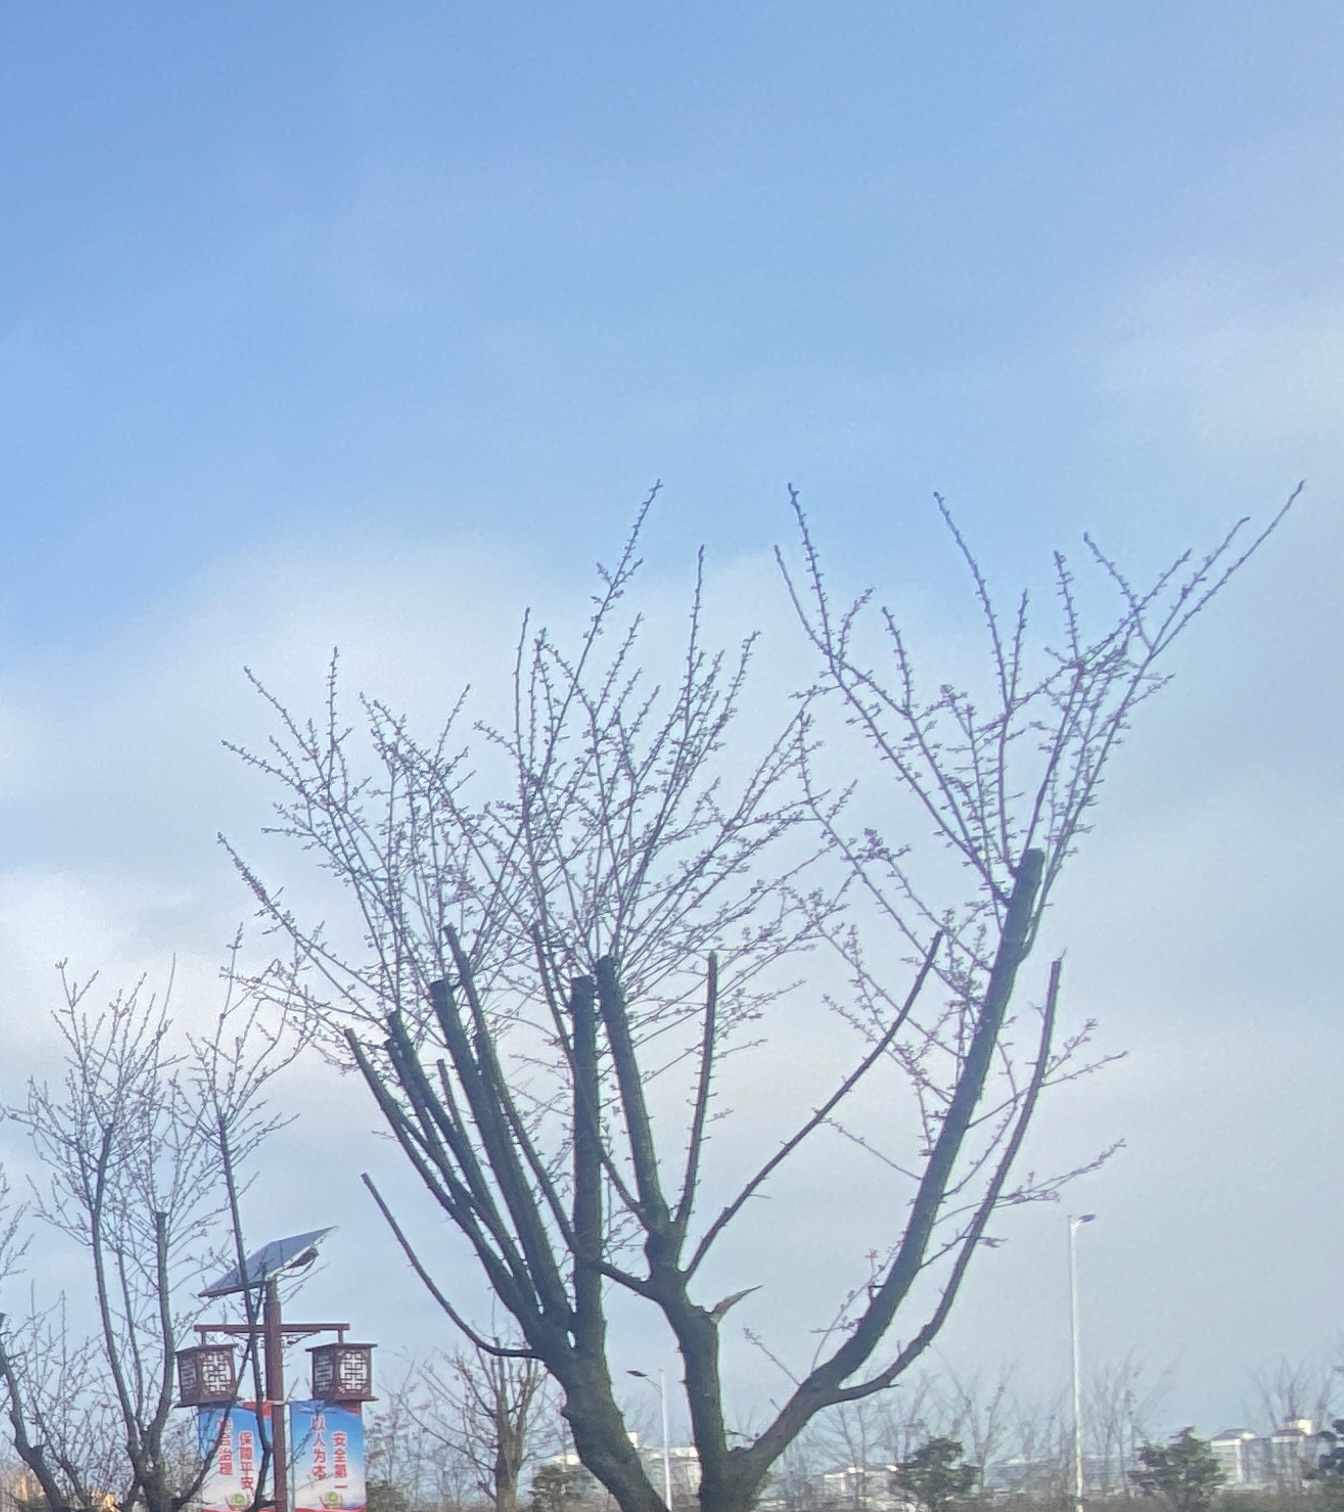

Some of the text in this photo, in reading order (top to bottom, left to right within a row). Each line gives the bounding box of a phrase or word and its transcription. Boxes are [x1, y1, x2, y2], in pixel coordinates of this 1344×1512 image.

[239, 1431, 254, 1490] 保障平安
[311, 1416, 326, 1480] 以人为本
[334, 1432, 348, 1489] 安全第一
